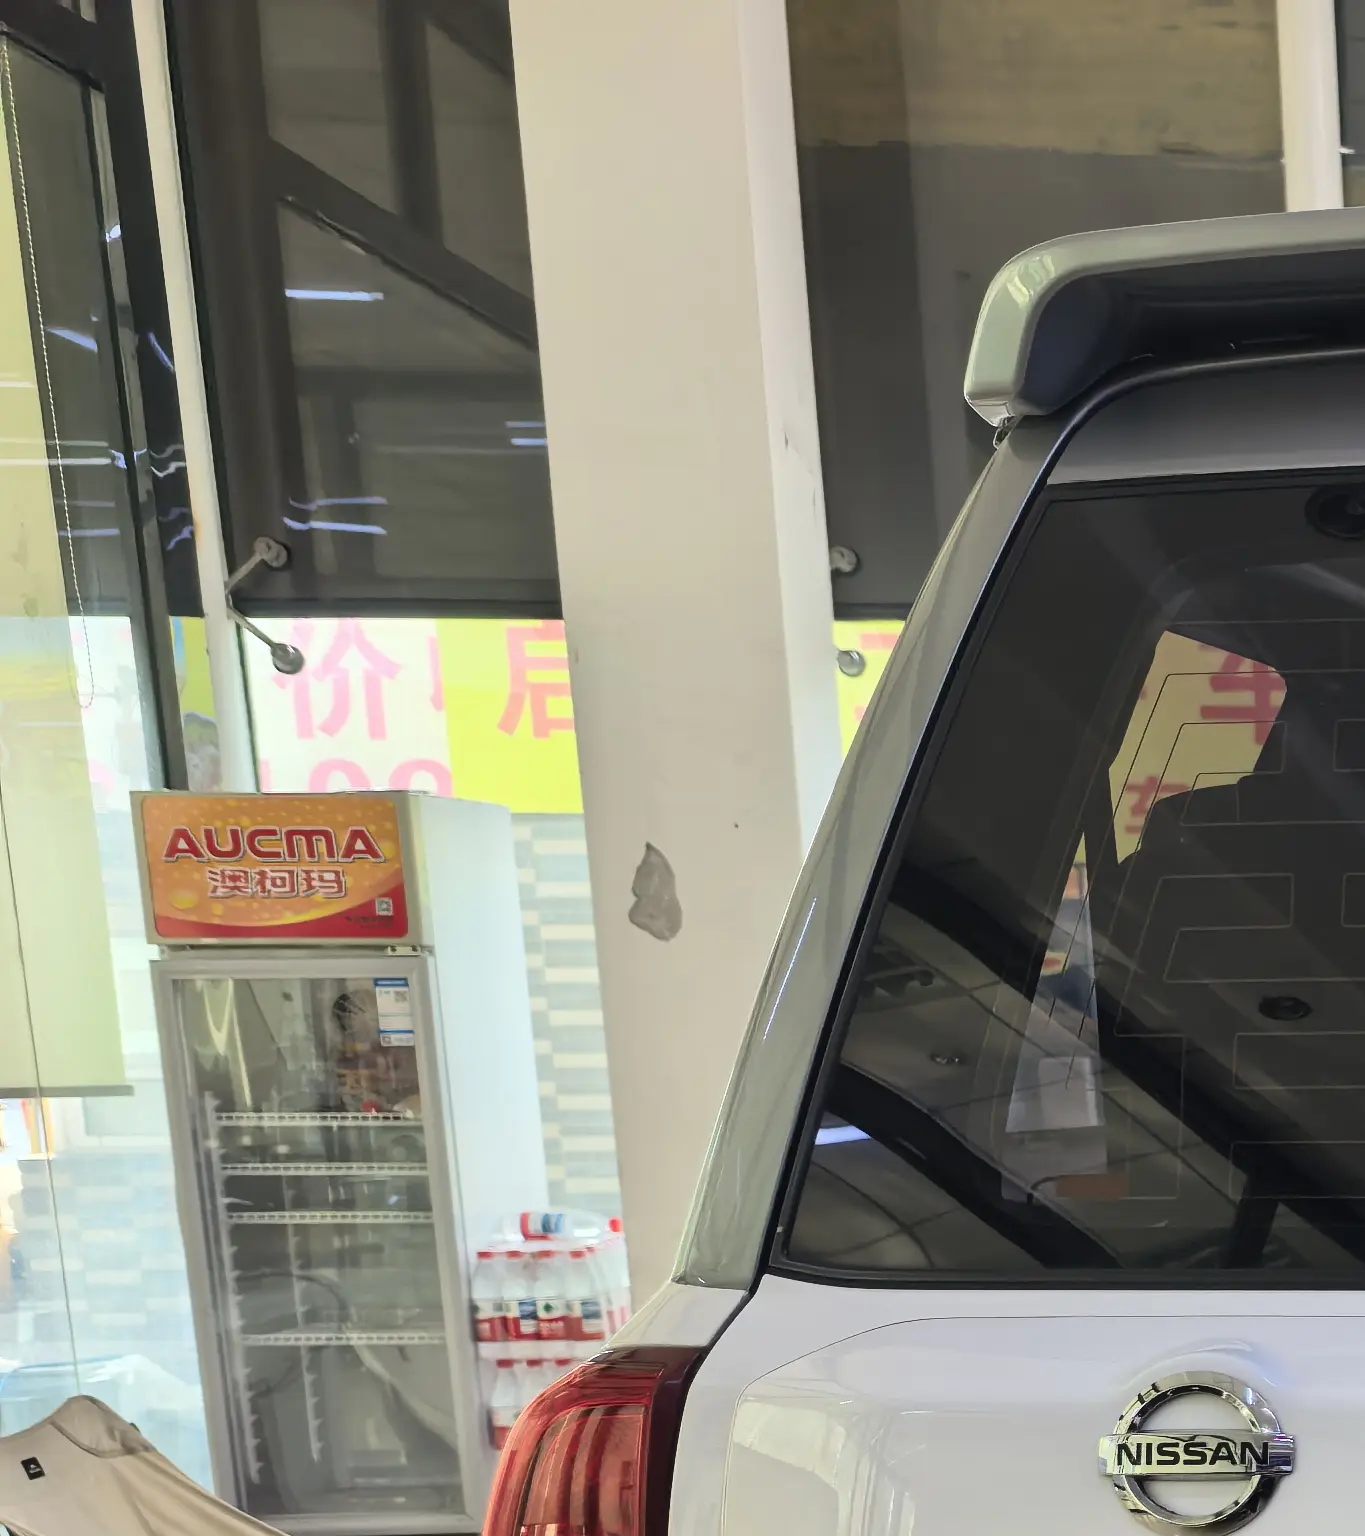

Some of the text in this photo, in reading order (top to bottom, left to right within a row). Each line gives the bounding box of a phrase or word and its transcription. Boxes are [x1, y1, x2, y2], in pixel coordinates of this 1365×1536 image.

[162, 826, 387, 863] AUCMA
[206, 866, 350, 899] 澳柯玛
[1114, 1440, 1272, 1467] NISSAN
